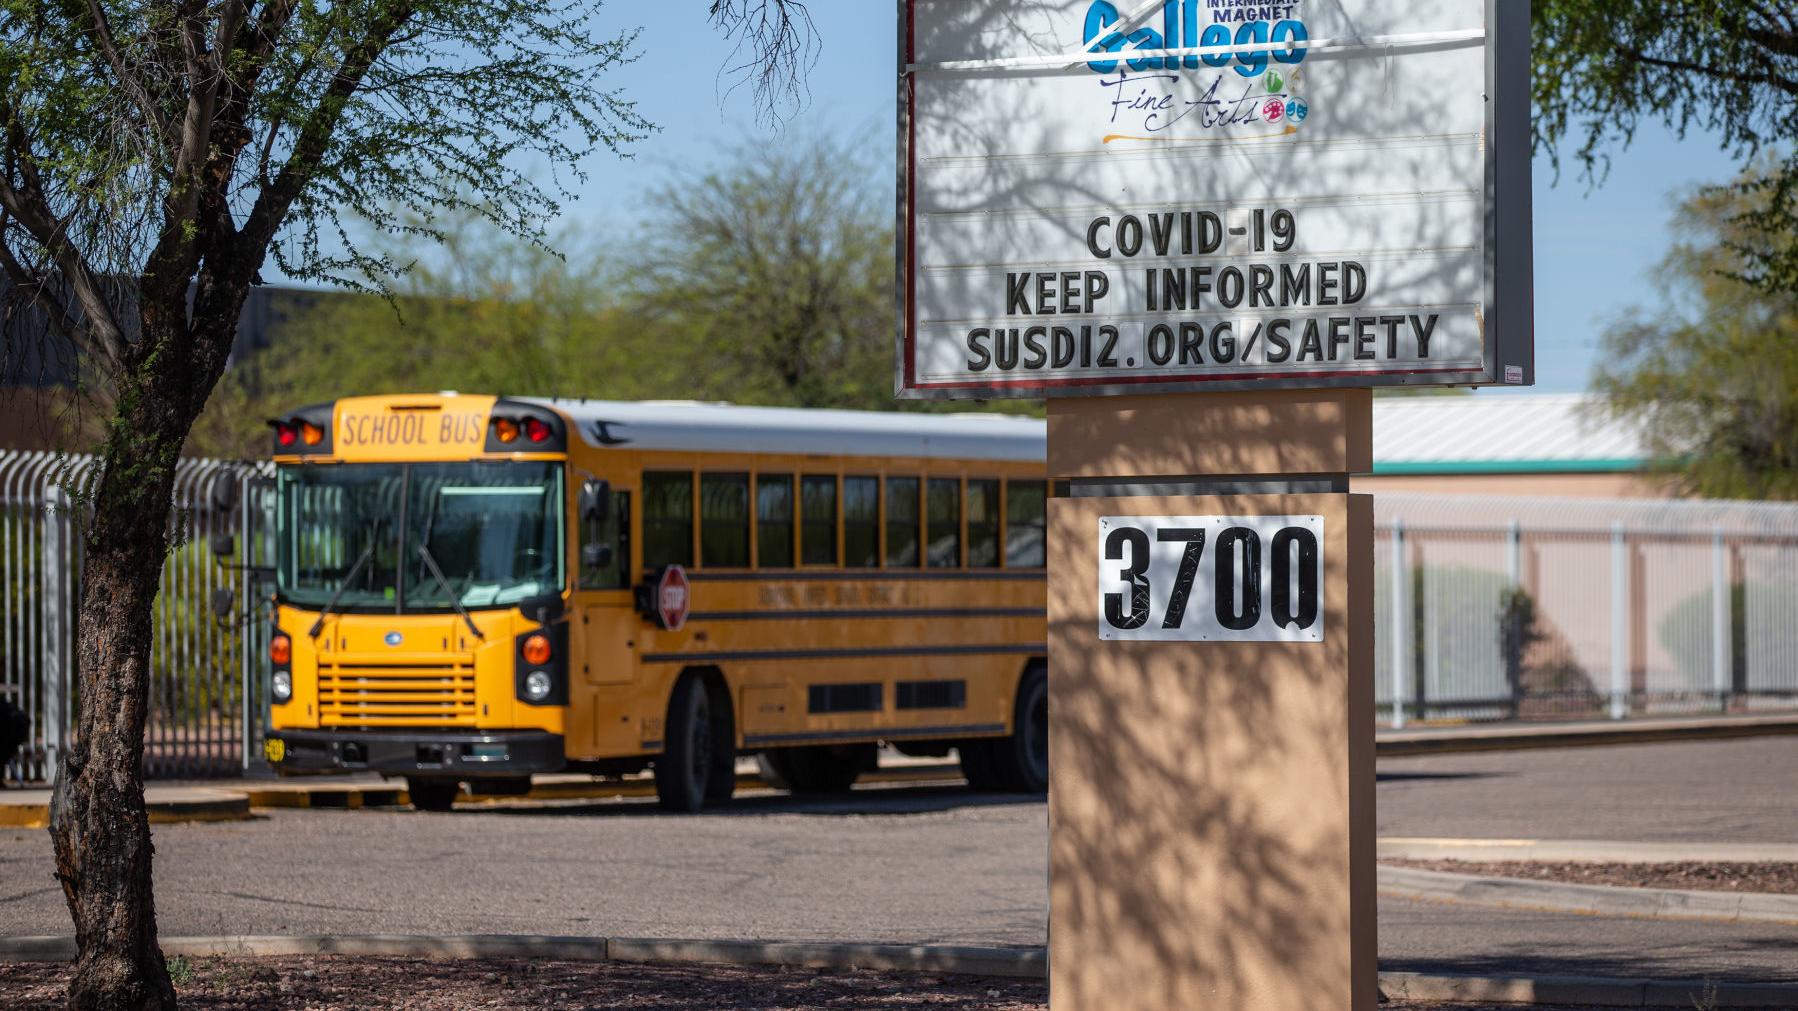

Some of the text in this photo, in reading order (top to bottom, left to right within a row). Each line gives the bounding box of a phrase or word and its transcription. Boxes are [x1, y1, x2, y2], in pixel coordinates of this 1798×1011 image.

[1083, 0, 1308, 77] Gallego
[1213, 5, 1294, 23] MAGNET
[1100, 69, 1288, 131] Fine Arts
[1086, 208, 1296, 259] COVID-19
[1006, 261, 1367, 315] KEEP INFORMED
[343, 413, 482, 446] SCHOOL BUS
[663, 586, 685, 609] STOP
[1104, 526, 1318, 631] 3700
